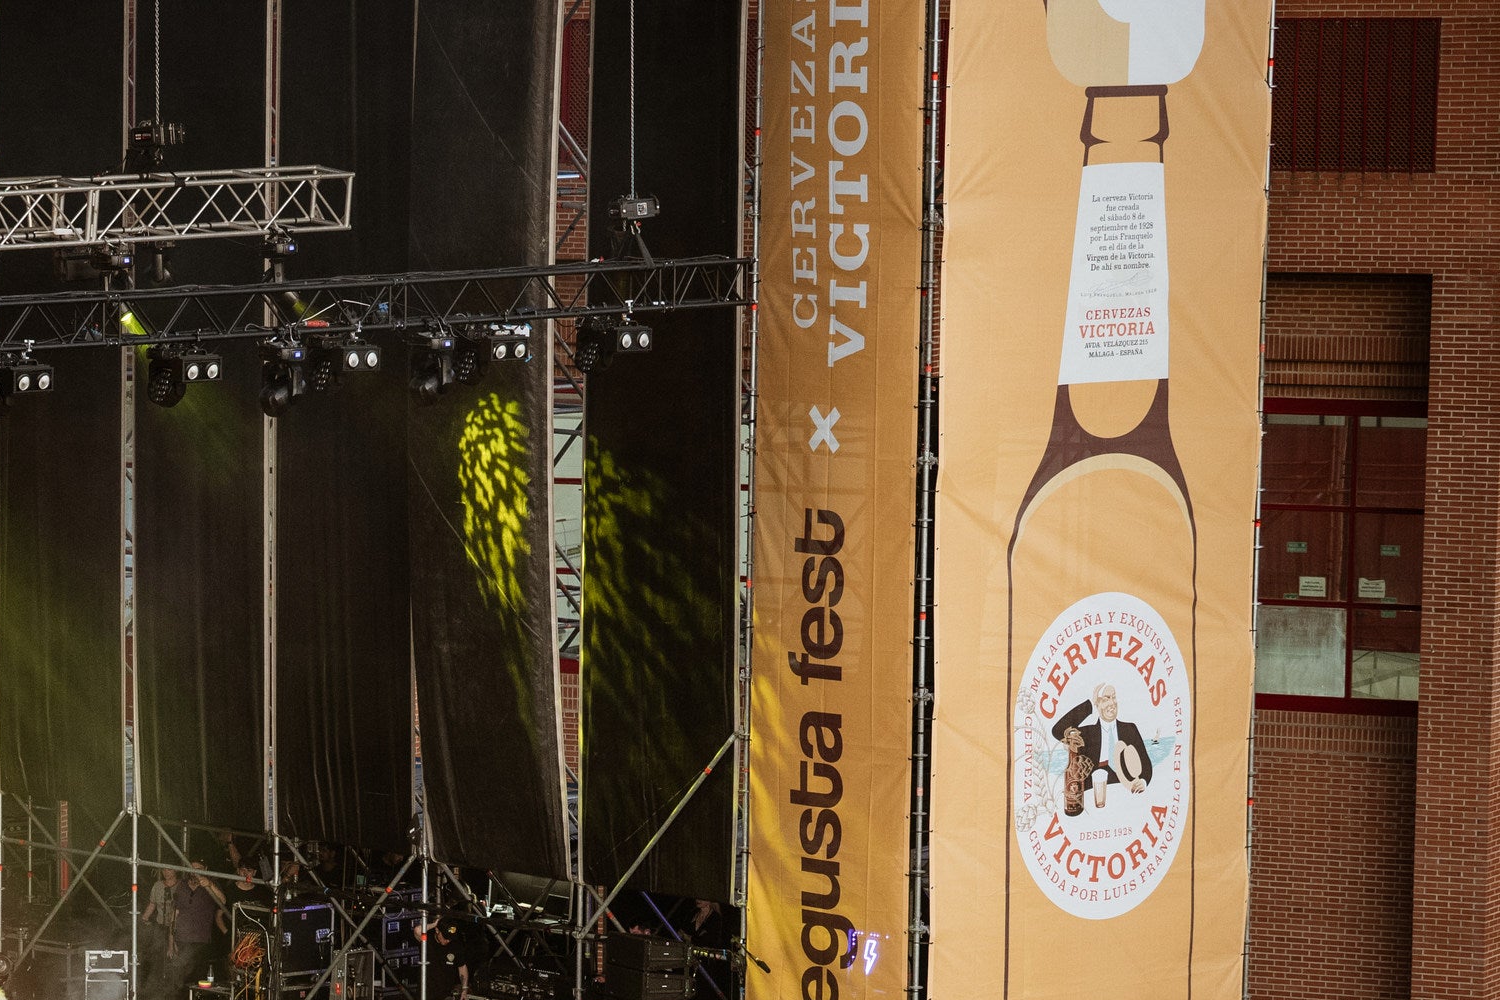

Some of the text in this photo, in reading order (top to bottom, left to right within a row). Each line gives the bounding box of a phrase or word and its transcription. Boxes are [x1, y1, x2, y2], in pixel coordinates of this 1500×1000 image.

[790, 0, 818, 328] CERVEZA
[1118, 203, 1139, 211] creada
[1090, 224, 1128, 233] septiembre
[1090, 235, 1101, 244] por
[1120, 232, 1153, 241] Franquelo
[1087, 254, 1108, 263] Virgen
[1086, 307, 1151, 320] CERVEZAS
[1079, 321, 1155, 338] VICTORIA
[1120, 348, 1143, 356] ESPAÑA
[788, 507, 847, 685] fest
[1039, 631, 1167, 719] CERVEZAS
[1023, 612, 1174, 802] CERVEZA MALAGUEÑA Y EXQUISITA
[1029, 697, 1182, 902] CREADA POR LUIS FRANQUELO EN 1928
[1080, 827, 1133, 841] DESDE 1928
[1044, 804, 1168, 883] VICTORIA
